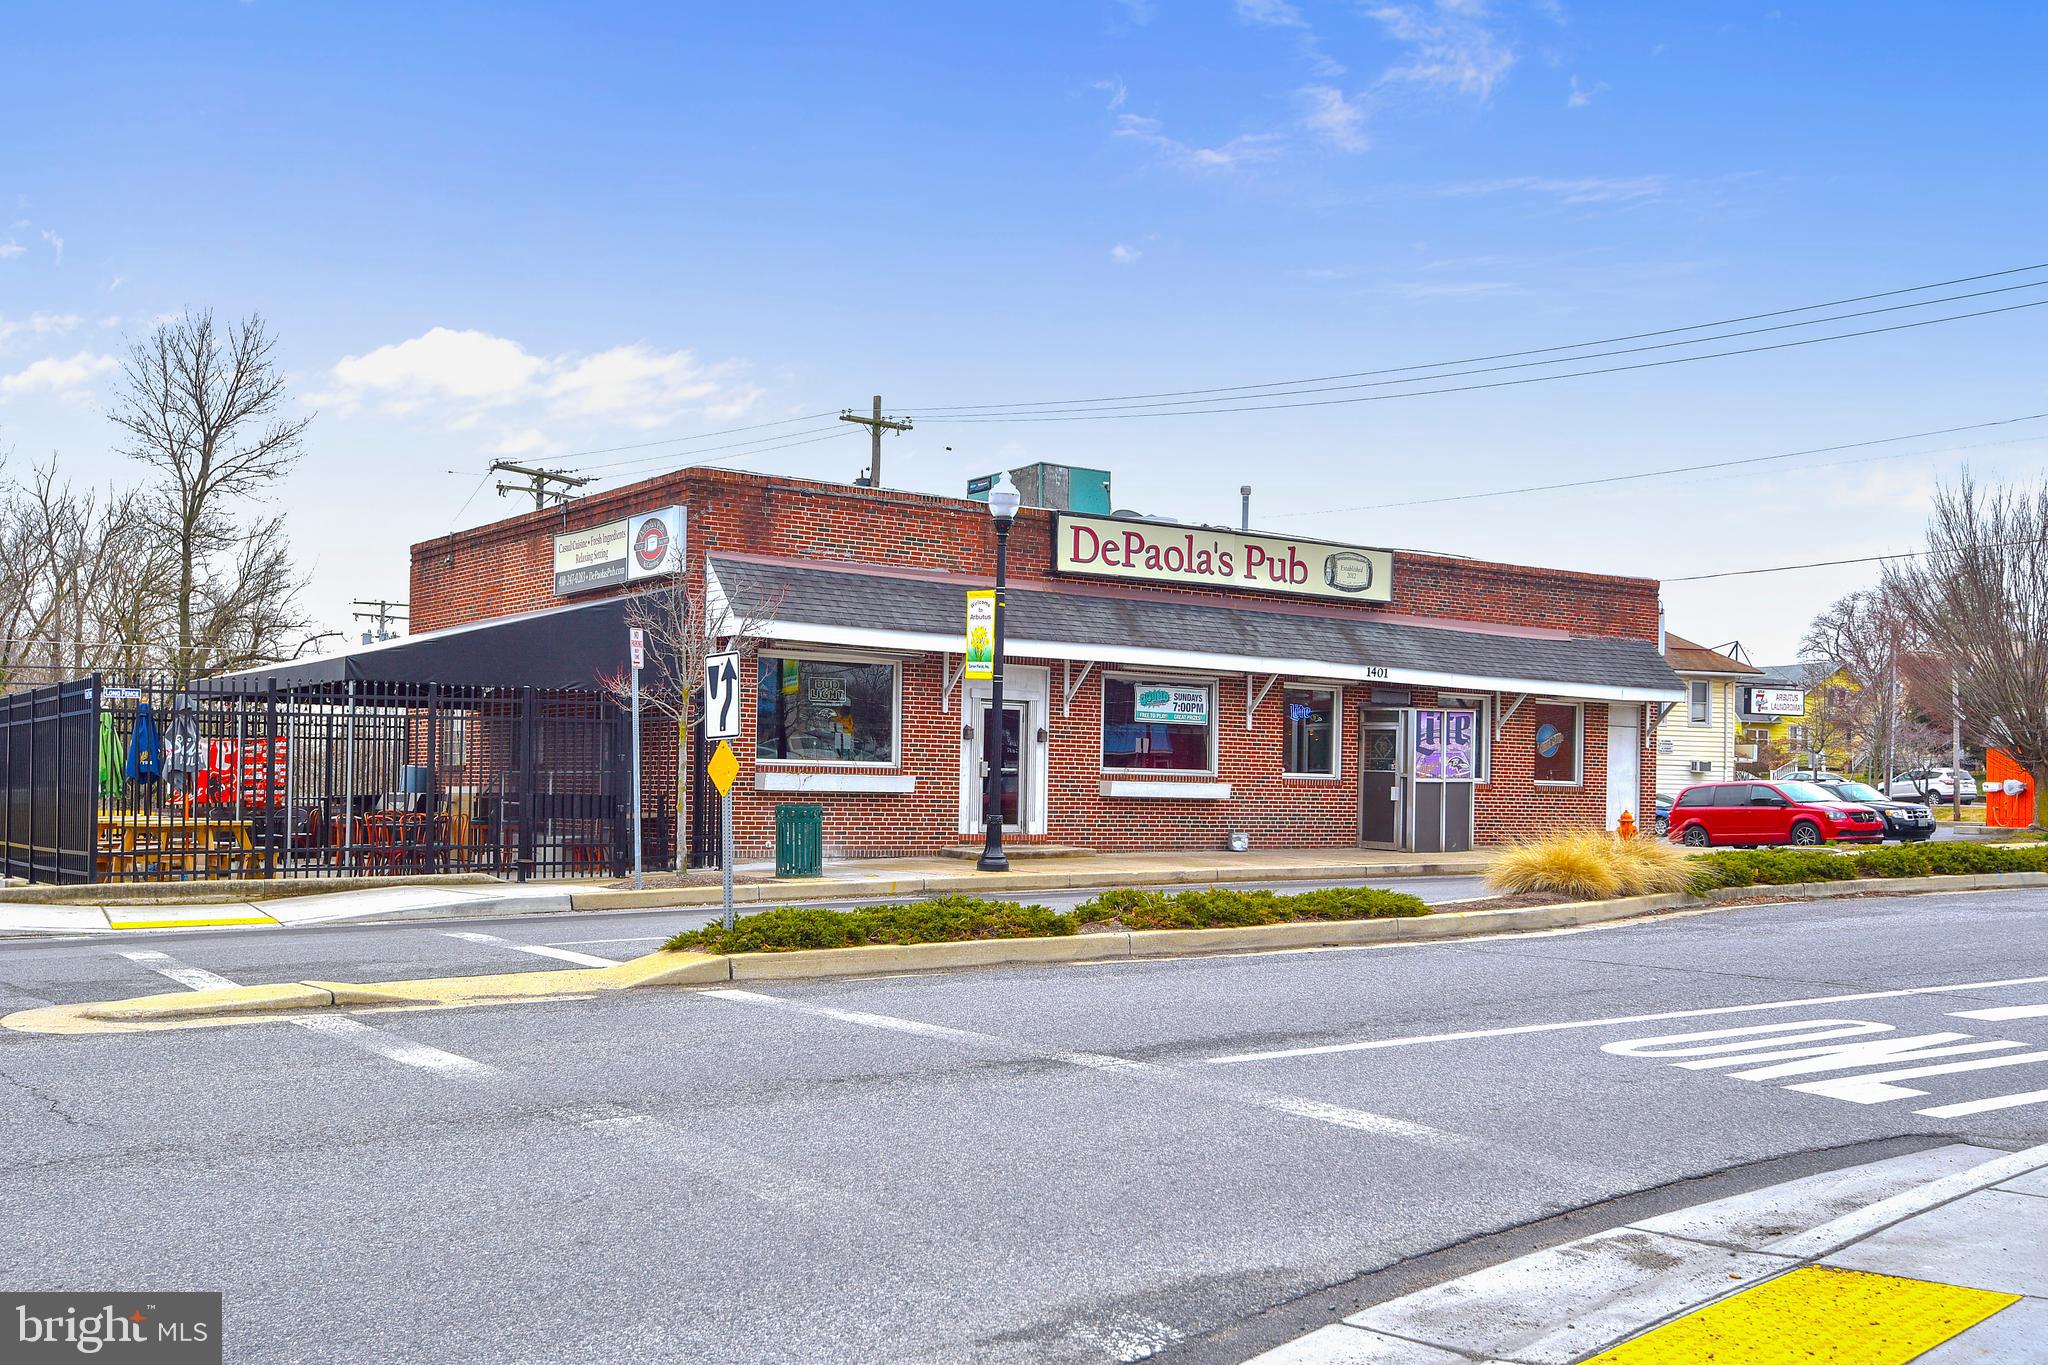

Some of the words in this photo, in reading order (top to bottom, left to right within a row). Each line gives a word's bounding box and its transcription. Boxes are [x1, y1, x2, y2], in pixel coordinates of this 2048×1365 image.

[591, 534, 603, 547] Fresh
[603, 529, 627, 546] Ingredients
[1069, 525, 1234, 577] DePaola's
[1243, 543, 1309, 585] Pub
[970, 600, 990, 608] Welcome
[1366, 666, 1388, 678] 1401
[814, 680, 840, 690] BUD
[810, 689, 845, 700] LIGHT
[1173, 693, 1203, 702] SUNDAYS
[1776, 694, 1799, 702] ARBUTUS
[1172, 702, 1204, 713] 7:00PM
[1289, 703, 1312, 721] Lite
[1771, 702, 1803, 711] LAUNDROMAT
